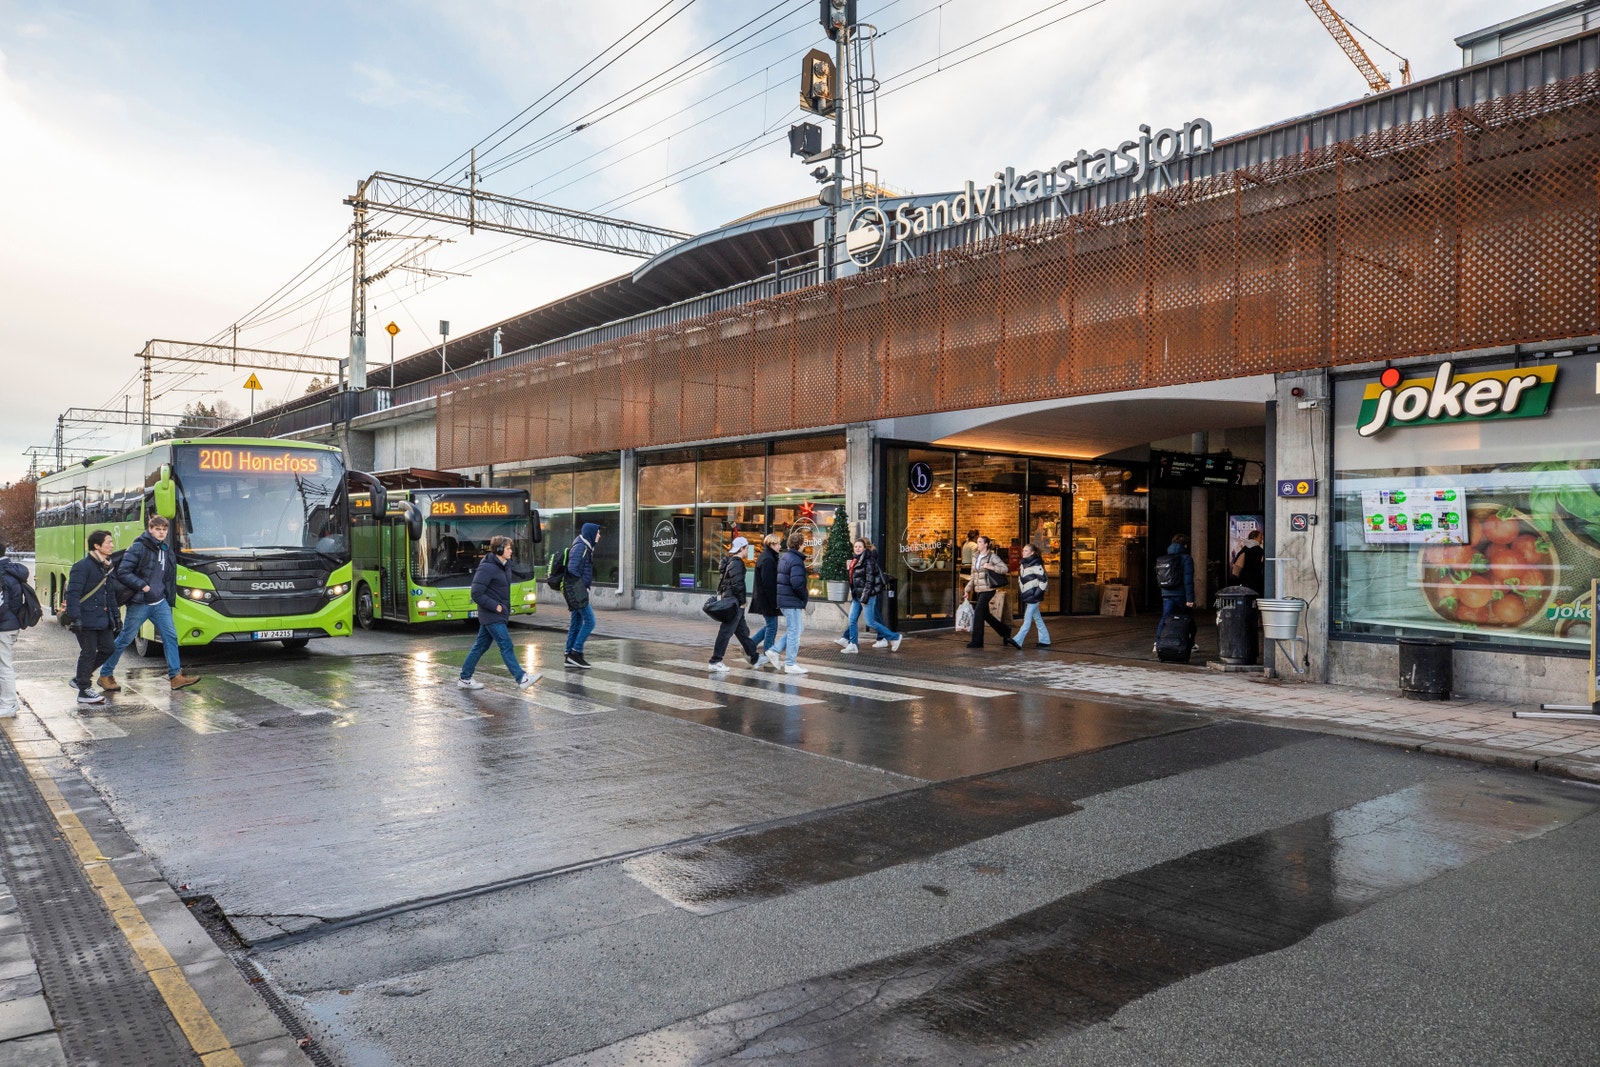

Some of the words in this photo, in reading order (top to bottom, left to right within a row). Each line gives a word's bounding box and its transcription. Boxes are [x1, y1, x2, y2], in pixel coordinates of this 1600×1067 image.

[896, 166, 1047, 240] Sandvika
[1055, 117, 1213, 192] stasjon
[1358, 361, 1541, 437] joker
[200, 450, 233, 469] 200
[239, 451, 317, 472] Hønefoss
[432, 502, 456, 514] 215A
[464, 502, 508, 514] Sandvika
[652, 537, 678, 548] backstube
[803, 537, 823, 547] stube
[900, 542, 942, 553] backstube
[251, 582, 295, 590] SCANIA
[1549, 600, 1592, 620] joke
